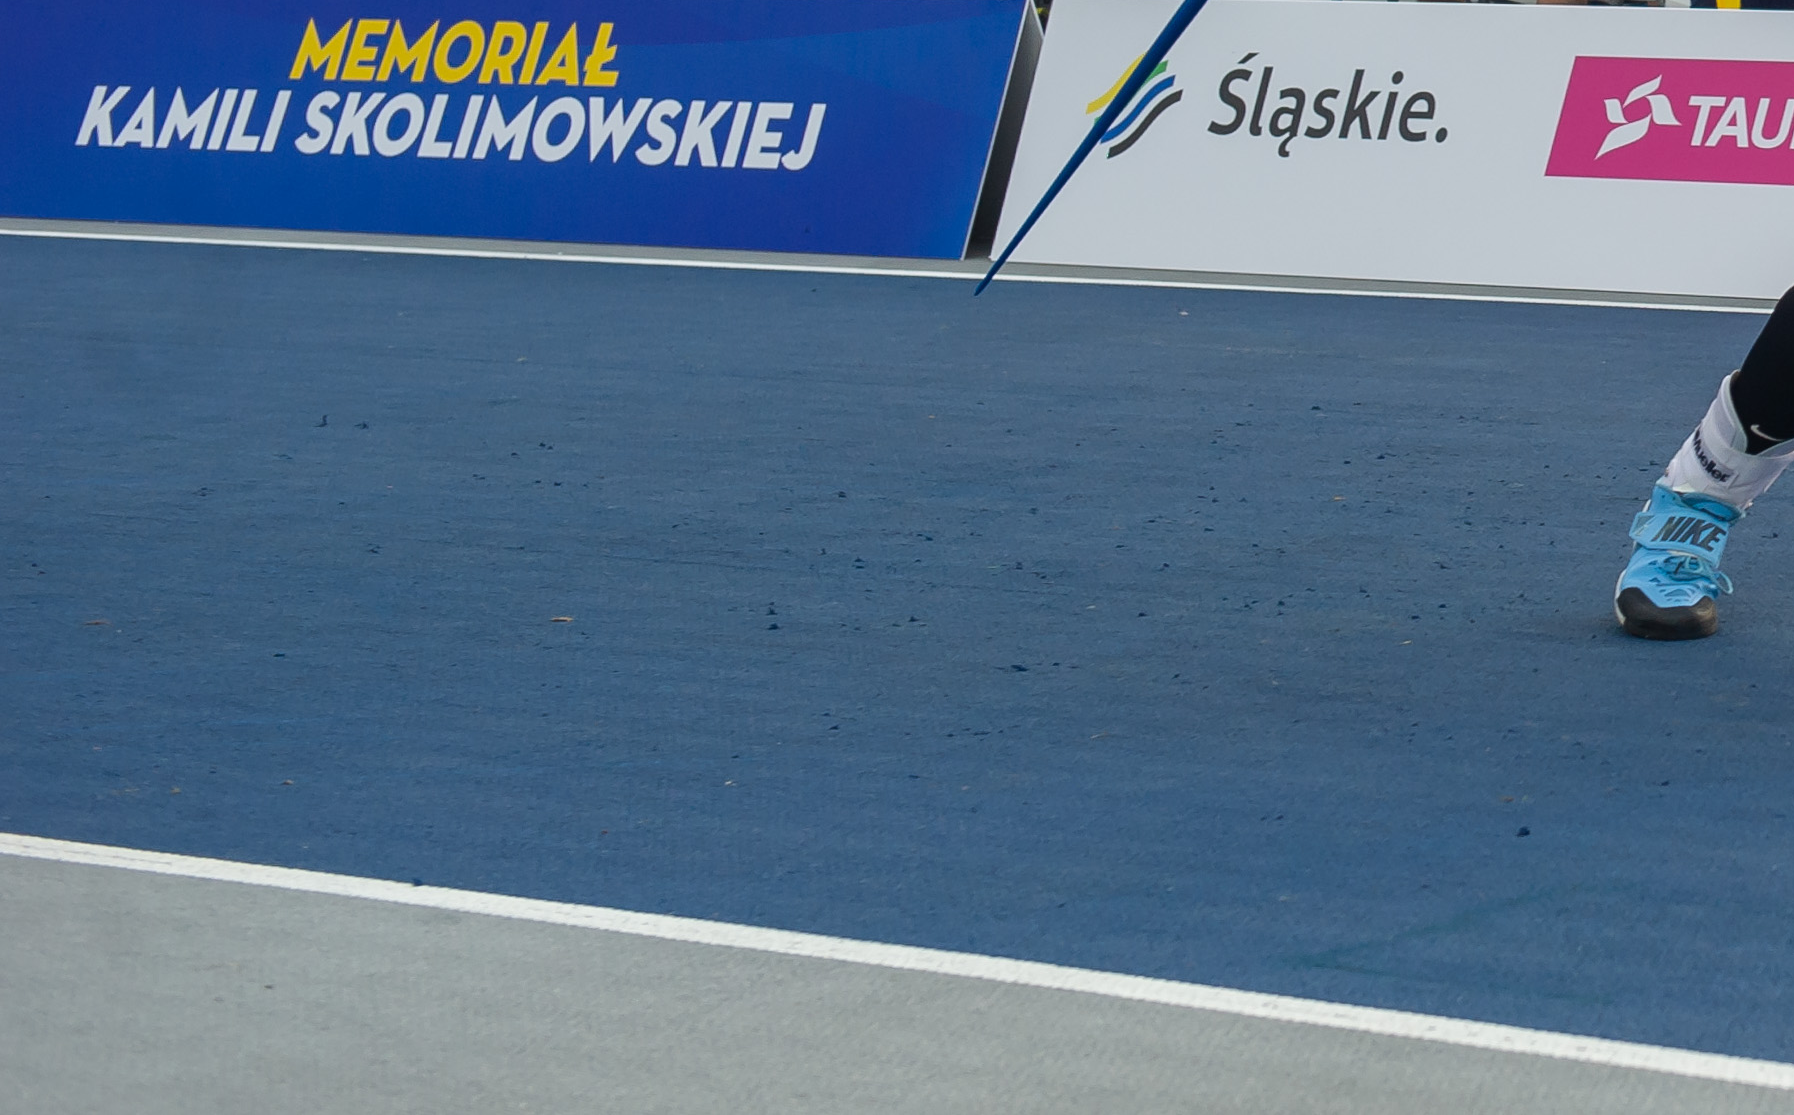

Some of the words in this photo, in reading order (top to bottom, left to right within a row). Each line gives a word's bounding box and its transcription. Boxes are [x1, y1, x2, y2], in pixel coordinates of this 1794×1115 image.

[290, 17, 620, 87] MEMORIAŁ
[75, 85, 291, 153] KAMILI
[295, 91, 828, 172] SKOLIMOWSKIEJ
[1207, 52, 1449, 157] Śląskie.
[1651, 516, 1727, 554] NIKE
